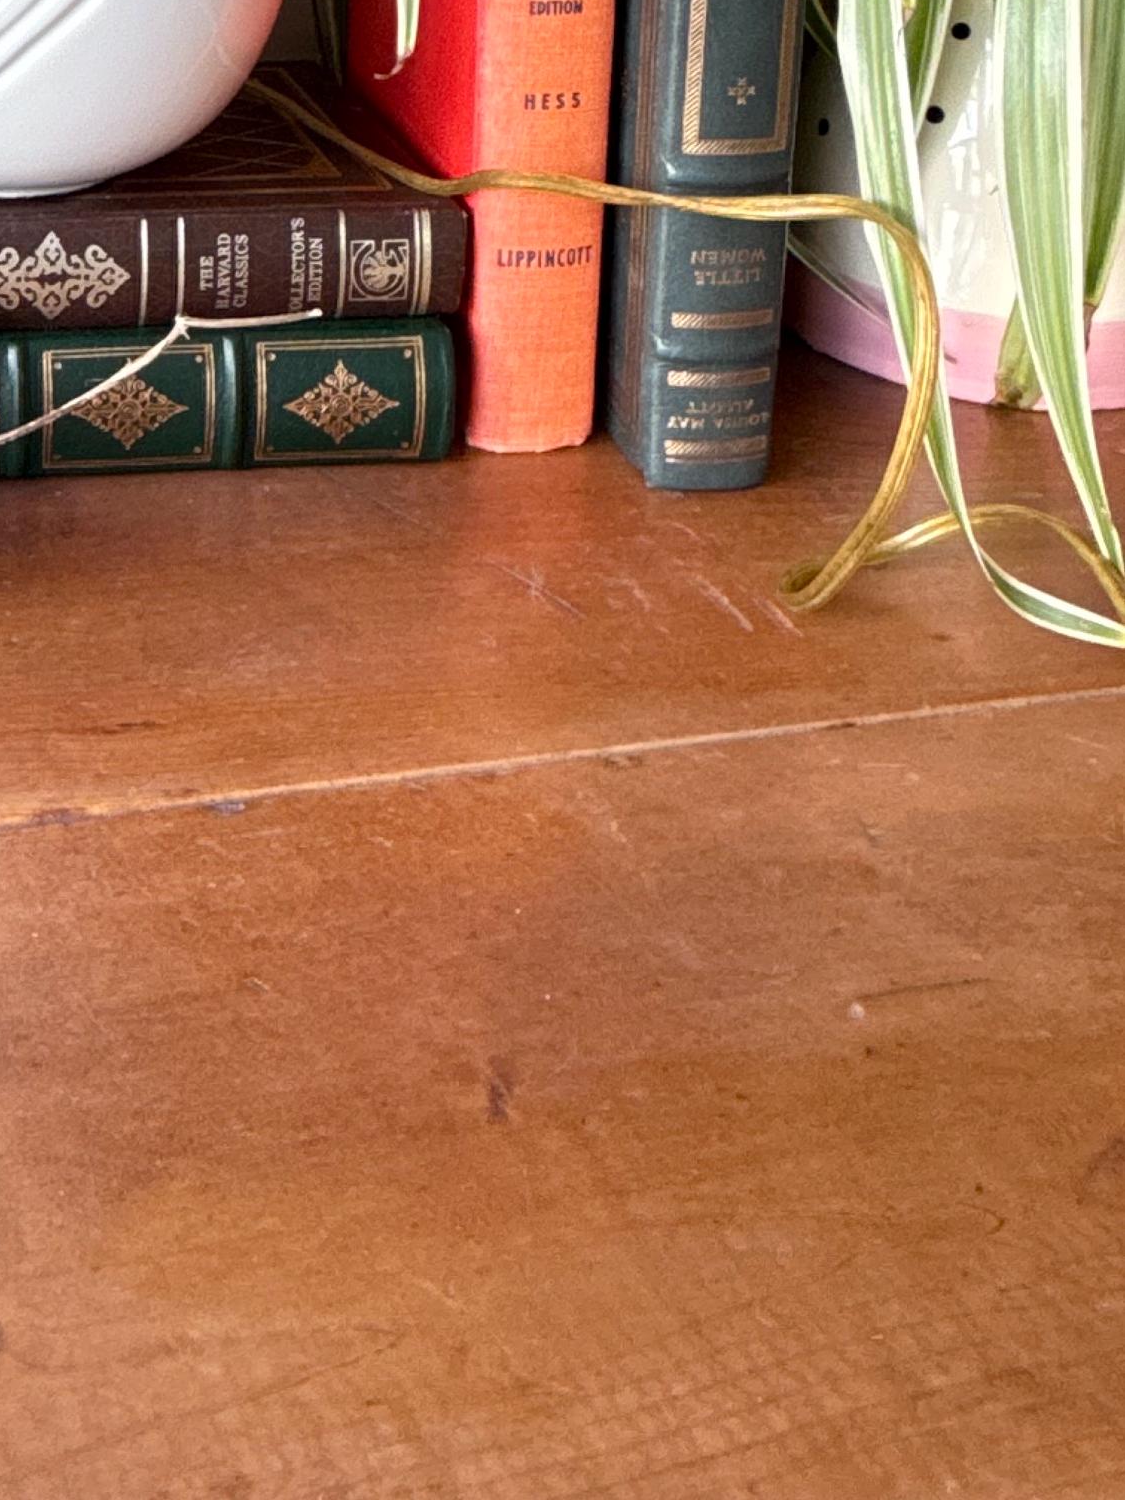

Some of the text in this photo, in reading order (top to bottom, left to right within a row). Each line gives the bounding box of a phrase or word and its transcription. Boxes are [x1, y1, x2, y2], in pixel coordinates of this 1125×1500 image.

[529, 0, 584, 16] EDITION
[524, 92, 581, 110] HESS
[289, 217, 306, 313] OLLECTOR'S
[497, 245, 594, 268] LIPPINCOTT
[690, 249, 766, 265] WOMEN
[200, 255, 214, 292] THE
[215, 232, 231, 309] HARVARD
[233, 234, 250, 308] CLASSICS
[308, 237, 323, 302] EDITION
[694, 269, 760, 285] LITTLE
[666, 415, 704, 429] MAY
